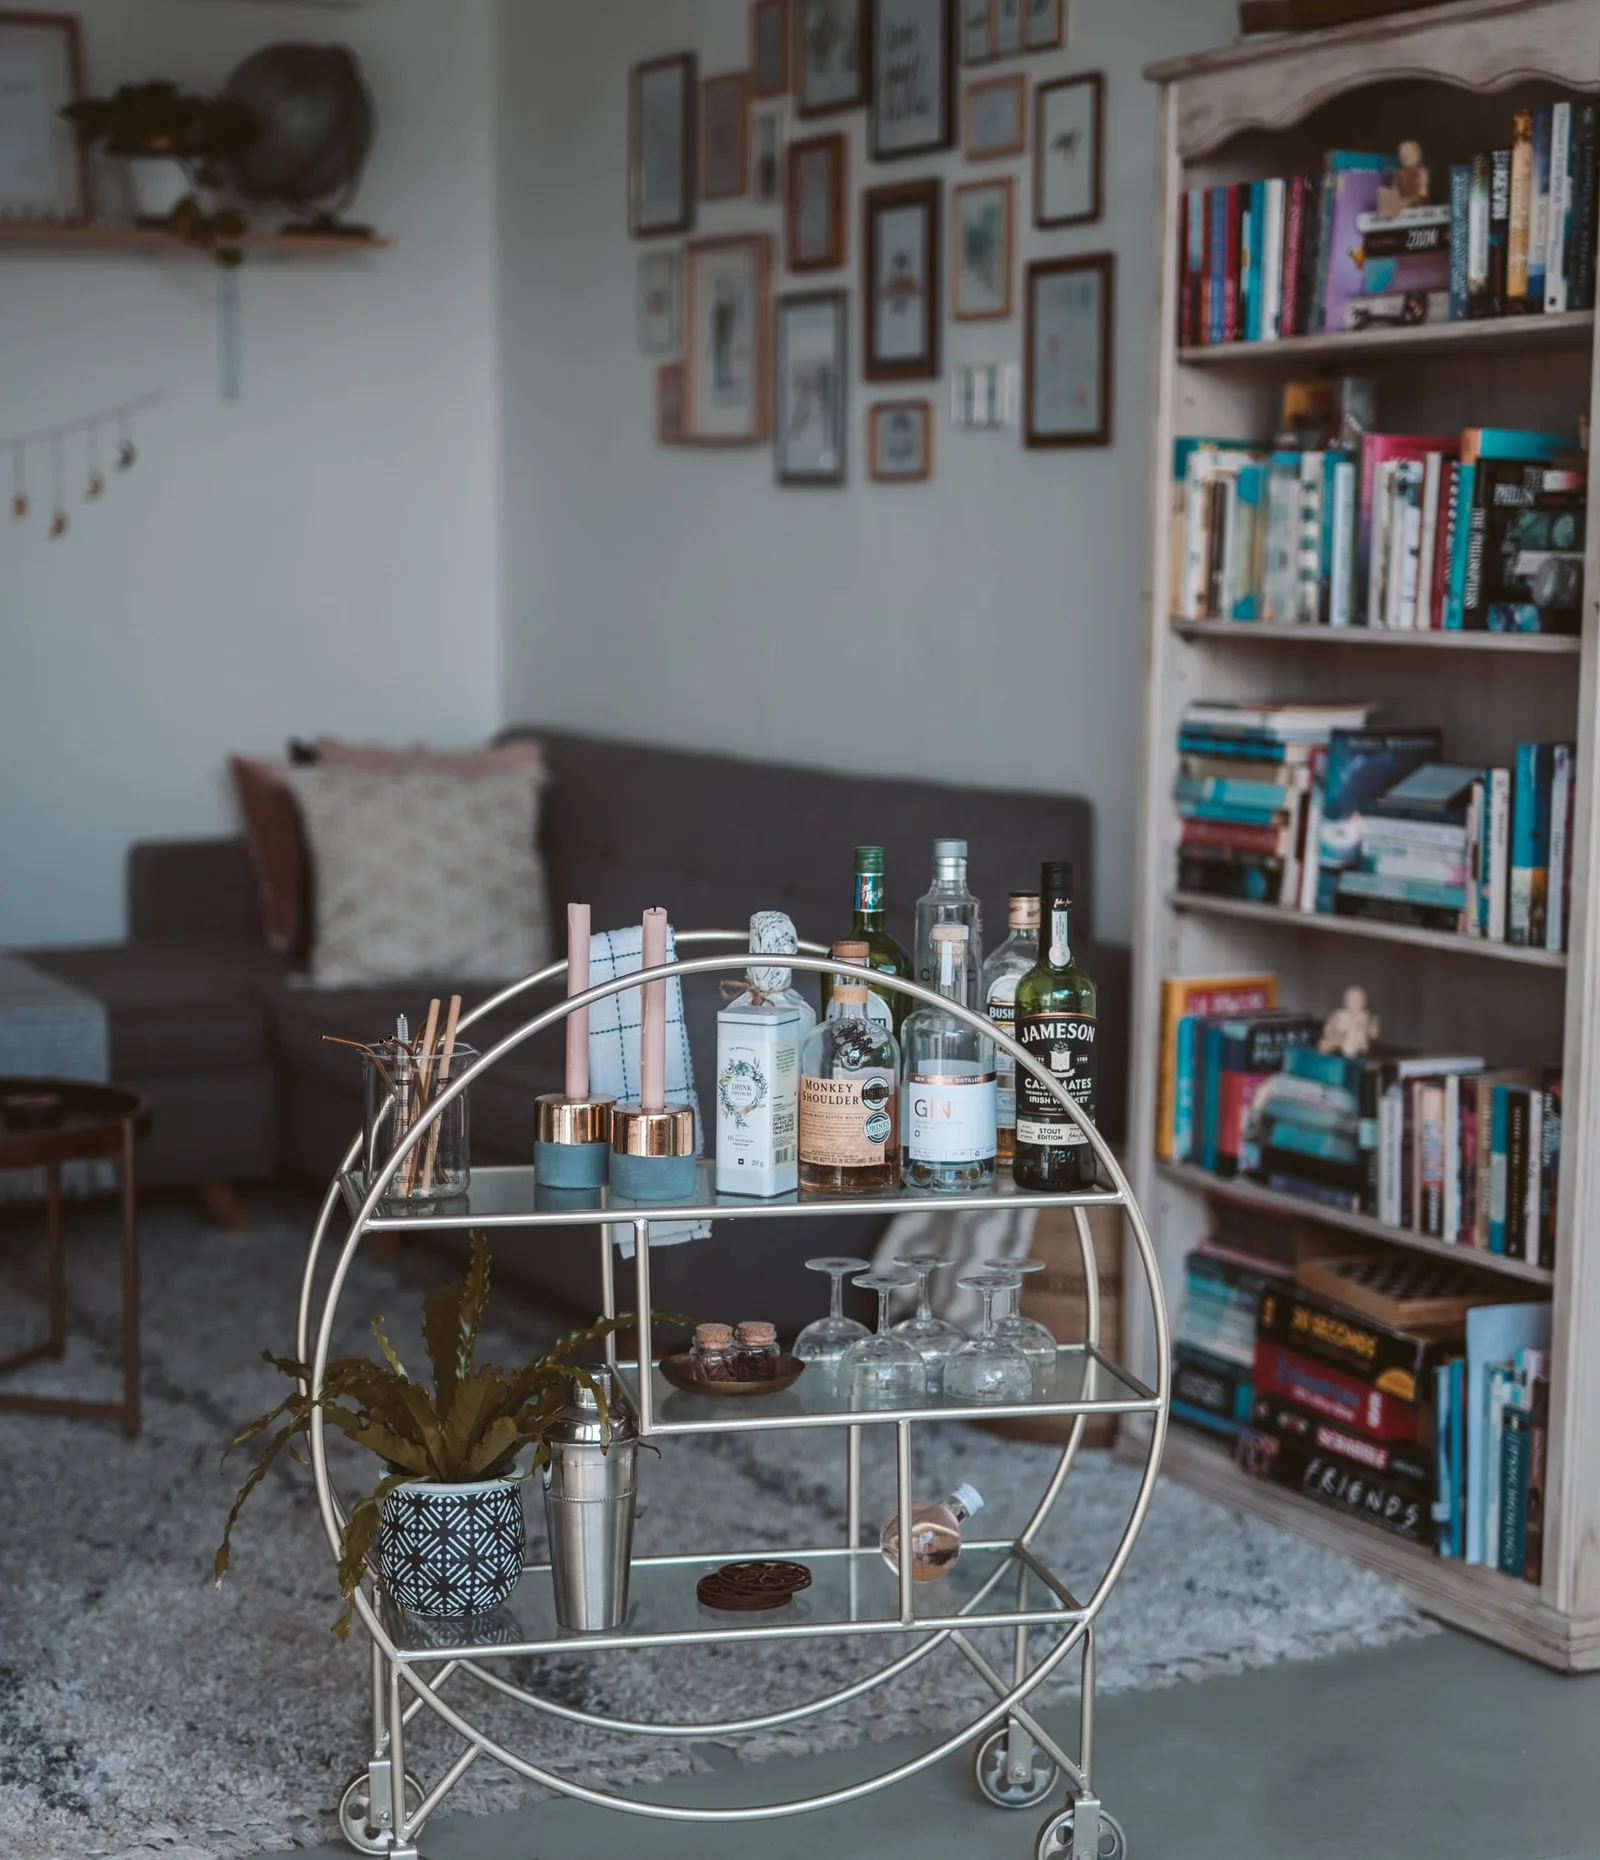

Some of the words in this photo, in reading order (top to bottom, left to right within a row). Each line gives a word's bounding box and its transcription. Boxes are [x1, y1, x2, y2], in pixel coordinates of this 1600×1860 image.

[1022, 1023, 1095, 1043] JAMESON
[731, 1083, 752, 1091] DRINK
[805, 1079, 853, 1093] MONKEY
[1025, 1078, 1091, 1090] CASMATES
[802, 1091, 859, 1105] SHOULDER
[1029, 1096, 1051, 1104] IRISH
[914, 1099, 951, 1118] GIN
[866, 1121, 889, 1132] DRINKS
[1304, 1458, 1419, 1534] FRIENDS
